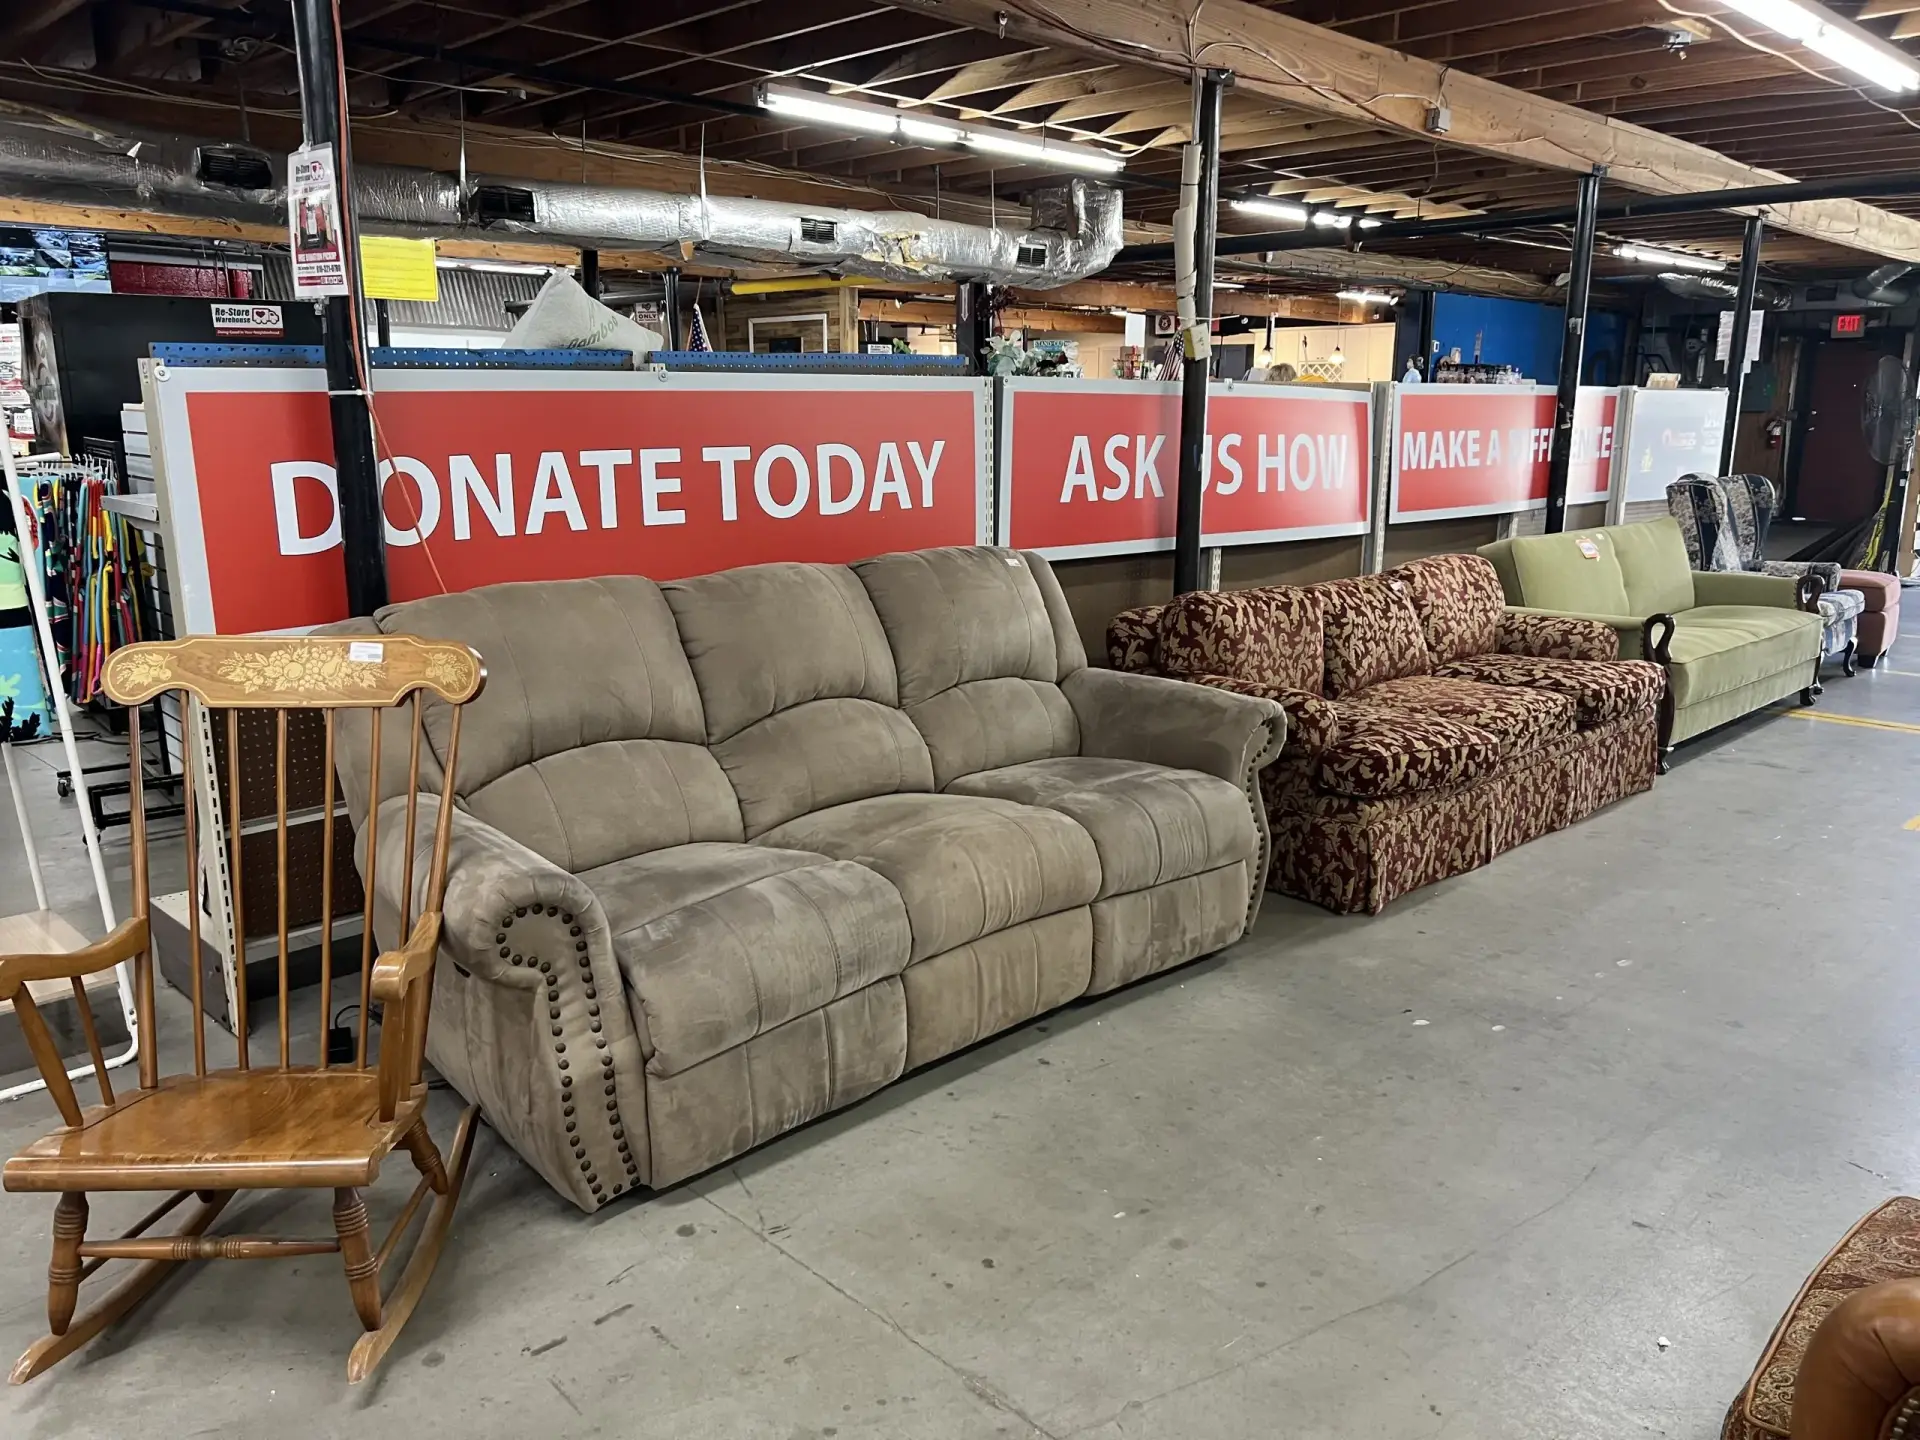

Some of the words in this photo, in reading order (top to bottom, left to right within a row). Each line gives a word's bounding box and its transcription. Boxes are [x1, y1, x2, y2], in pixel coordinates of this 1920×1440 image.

[215, 307, 250, 317] Re-Store
[1837, 315, 1861, 332] EXIT
[1059, 433, 1166, 503] ASK
[1257, 433, 1348, 493] HOW
[1402, 429, 1481, 470] MAKE
[1486, 429, 1499, 465] A
[269, 447, 687, 556] DONATE
[702, 440, 946, 519] TODAY
